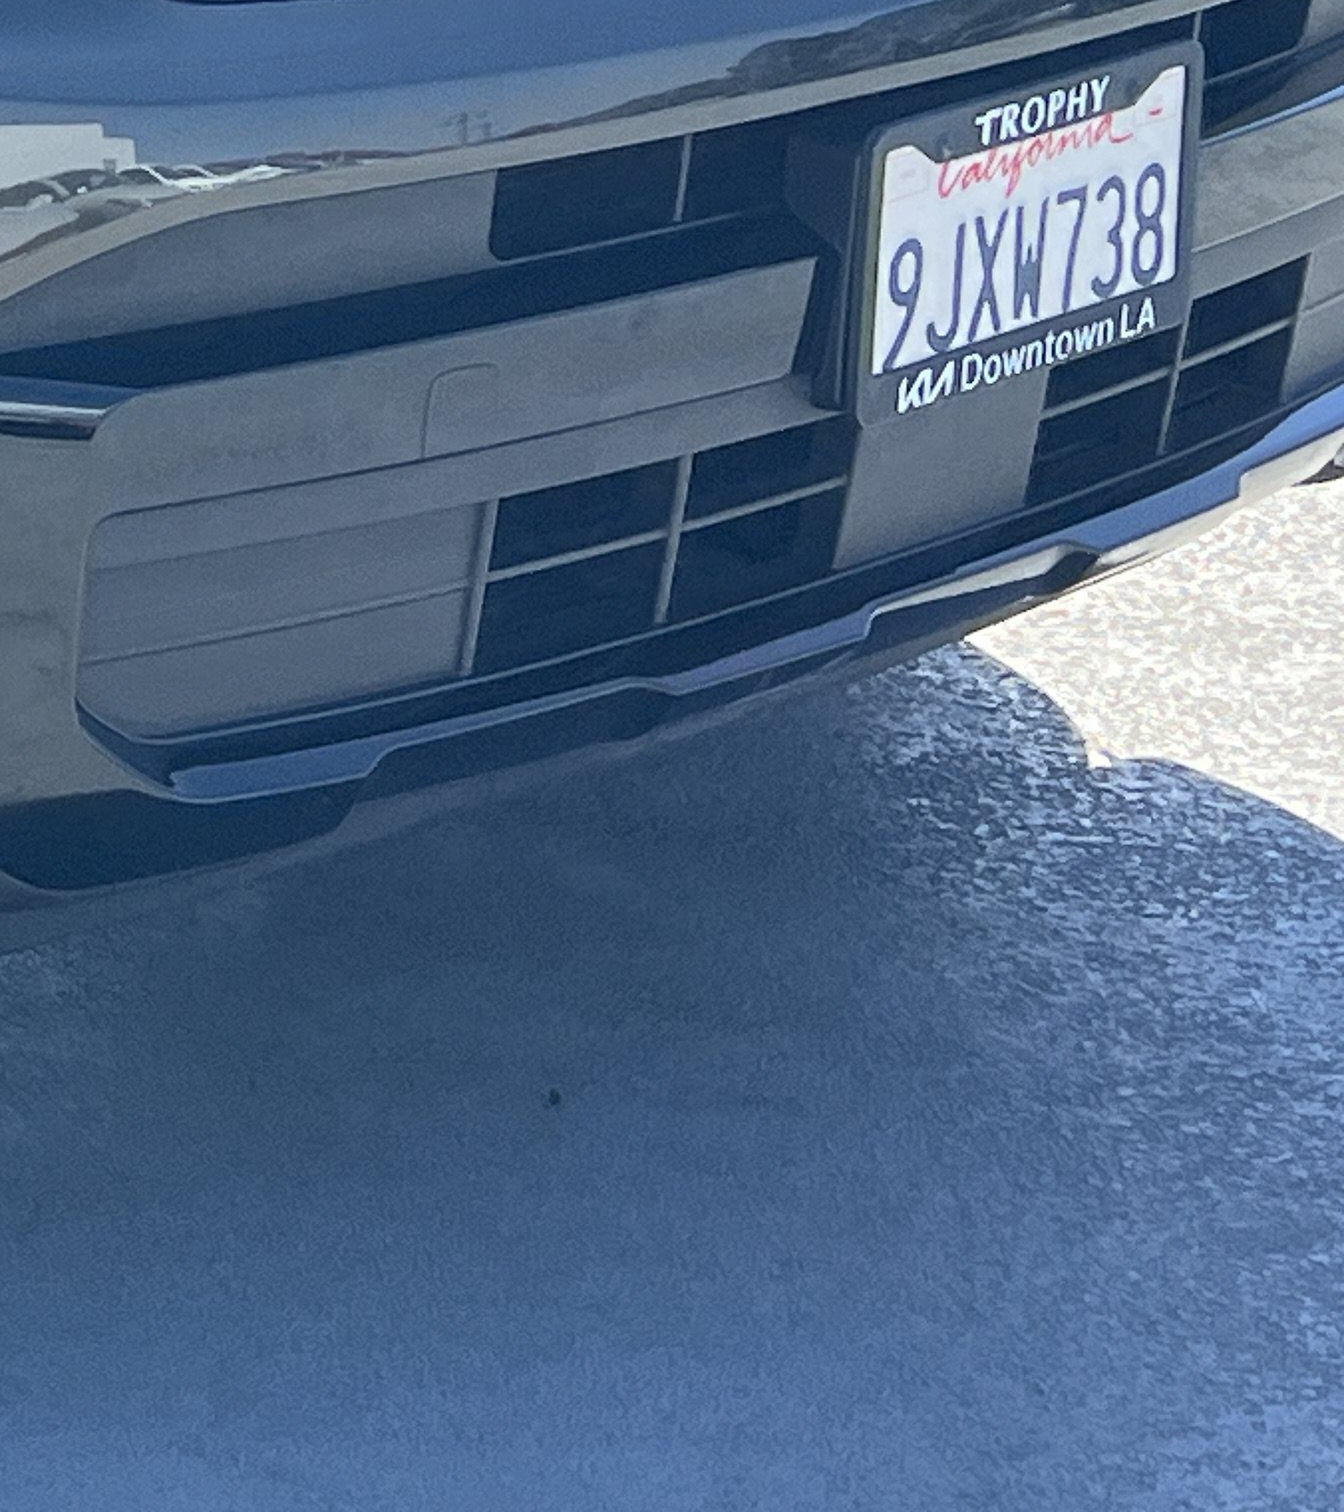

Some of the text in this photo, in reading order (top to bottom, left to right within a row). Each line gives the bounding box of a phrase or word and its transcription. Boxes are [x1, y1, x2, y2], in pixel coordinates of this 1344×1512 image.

[974, 75, 1111, 146] TROPHY
[882, 162, 1167, 372] 9JXW738
[896, 297, 1157, 415] KIA Downtown LA
